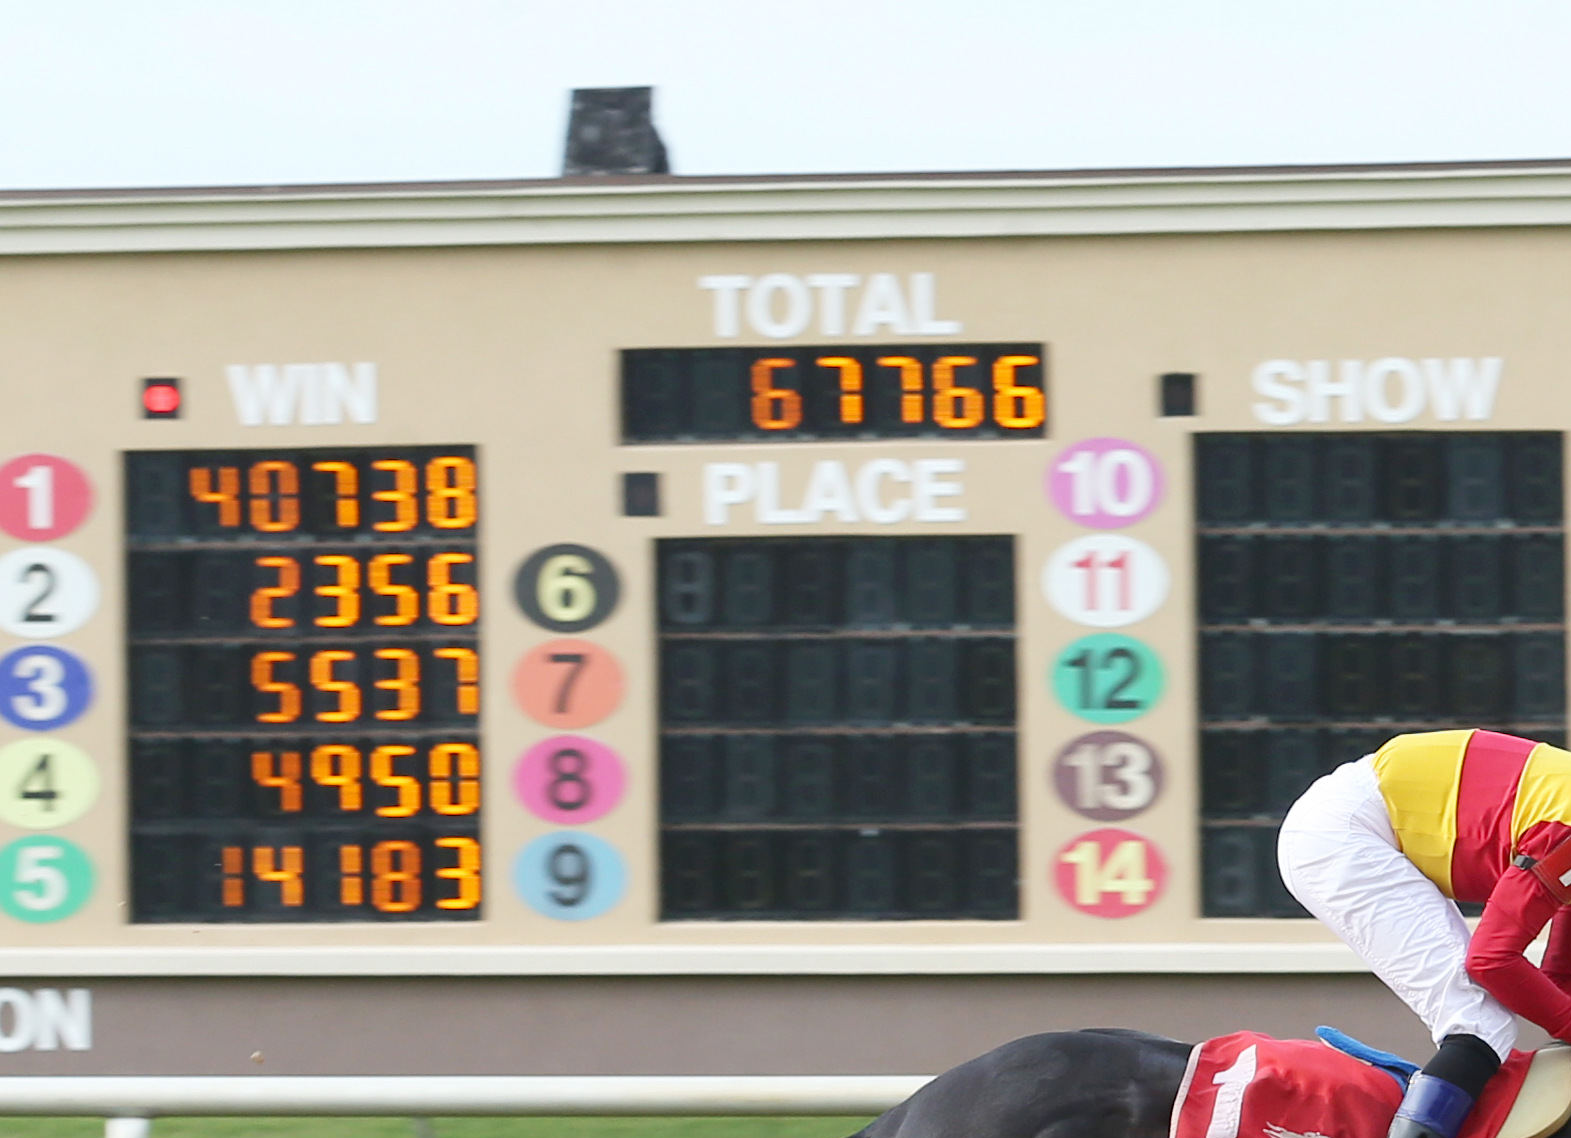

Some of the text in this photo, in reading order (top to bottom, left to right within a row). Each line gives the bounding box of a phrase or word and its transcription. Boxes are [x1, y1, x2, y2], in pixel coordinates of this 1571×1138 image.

[698, 272, 963, 339] TOTAL
[225, 361, 378, 426] WIN
[750, 354, 1046, 430] 67766
[1251, 356, 1504, 426] SHOW
[13, 464, 55, 529] 1
[189, 455, 478, 533] 40738
[702, 457, 968, 526] PLACE
[1057, 449, 1154, 516] 10
[16, 562, 59, 624] 2
[249, 551, 479, 629] 2356
[535, 553, 598, 622] 6
[1069, 549, 1133, 612] 11
[11, 654, 66, 722] 3
[251, 647, 479, 723] 5537
[547, 653, 589, 714] 7
[1062, 648, 1145, 710] 12
[18, 754, 62, 812] 4
[251, 742, 481, 818] 4950
[546, 749, 593, 811] 8
[1062, 742, 1156, 810] 13
[12, 845, 69, 910] 5
[222, 836, 483, 913] 14183
[546, 844, 593, 907] 9
[1060, 840, 1155, 906] 14
[0, 987, 92, 1053] ON
